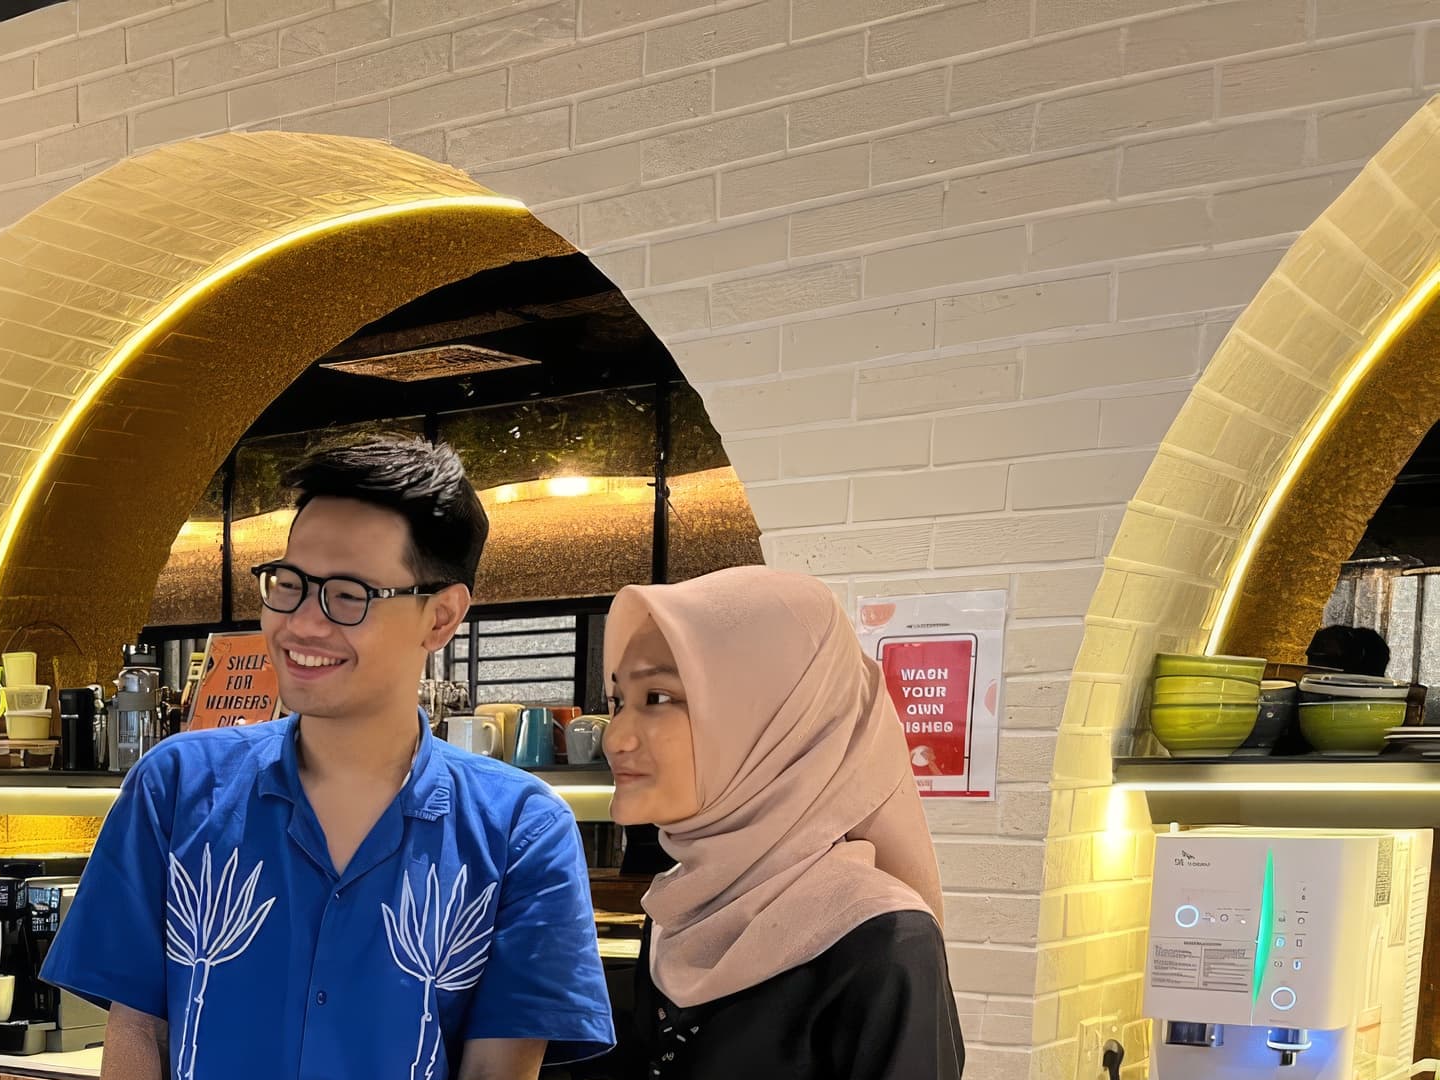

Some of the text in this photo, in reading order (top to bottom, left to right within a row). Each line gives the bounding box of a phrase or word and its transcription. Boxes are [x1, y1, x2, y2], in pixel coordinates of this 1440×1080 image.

[901, 668, 948, 680] WASH
[226, 675, 252, 690] FOR
[902, 686, 946, 698] YOUR
[906, 704, 944, 715] OWN
[905, 721, 953, 733] ISHES
